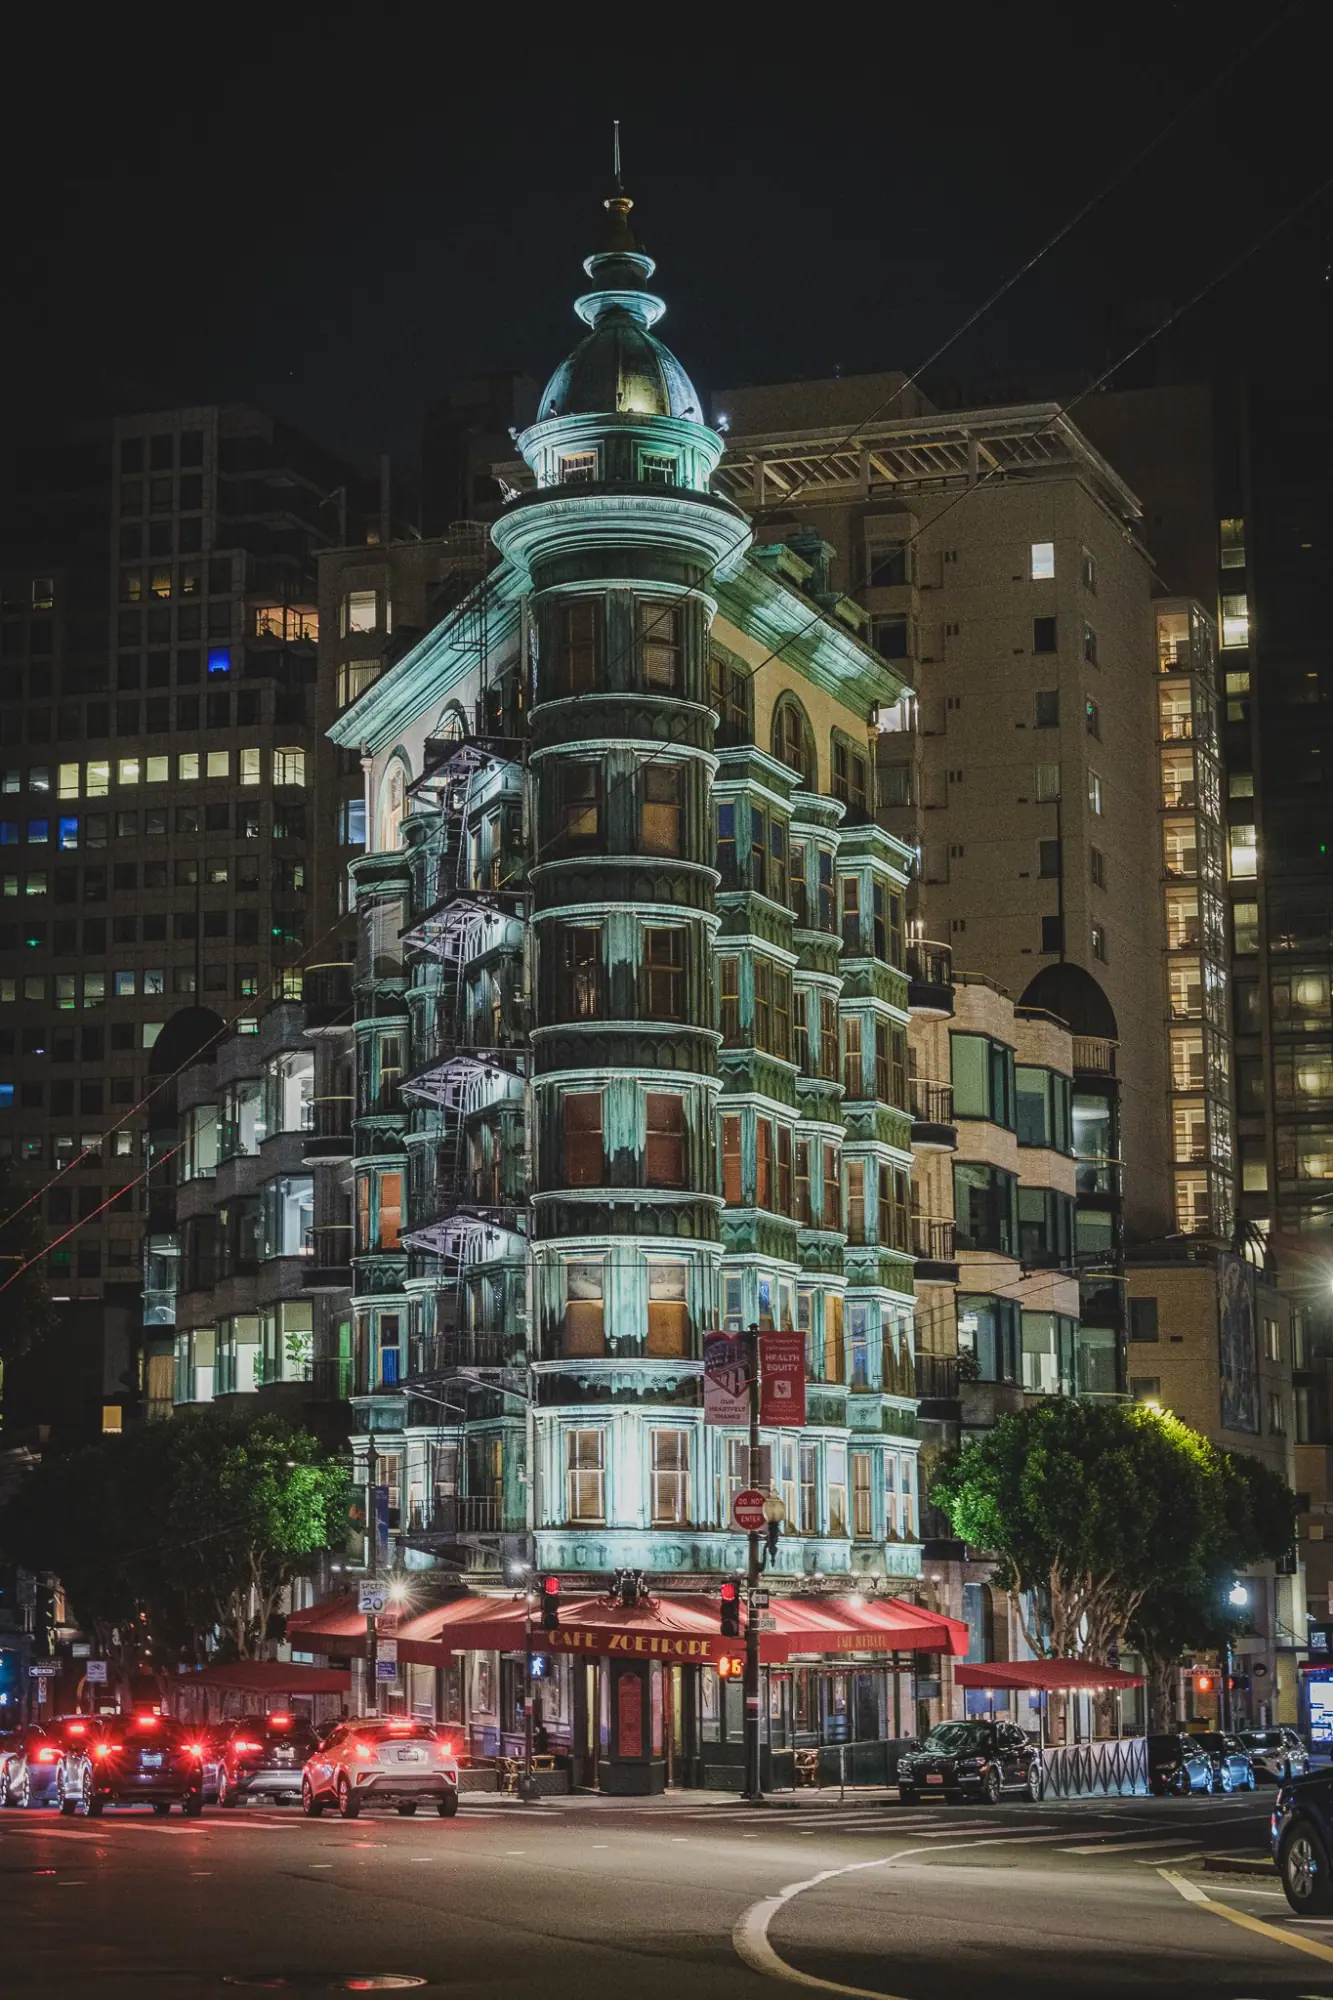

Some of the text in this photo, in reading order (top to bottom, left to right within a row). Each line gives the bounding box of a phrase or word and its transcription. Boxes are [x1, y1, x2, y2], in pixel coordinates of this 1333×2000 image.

[765, 1353, 800, 1361] HEALTH
[766, 1363, 798, 1371] EQUITY
[362, 1597, 383, 1610] 20
[548, 1630, 712, 1656] CAFE ZOETROPE
